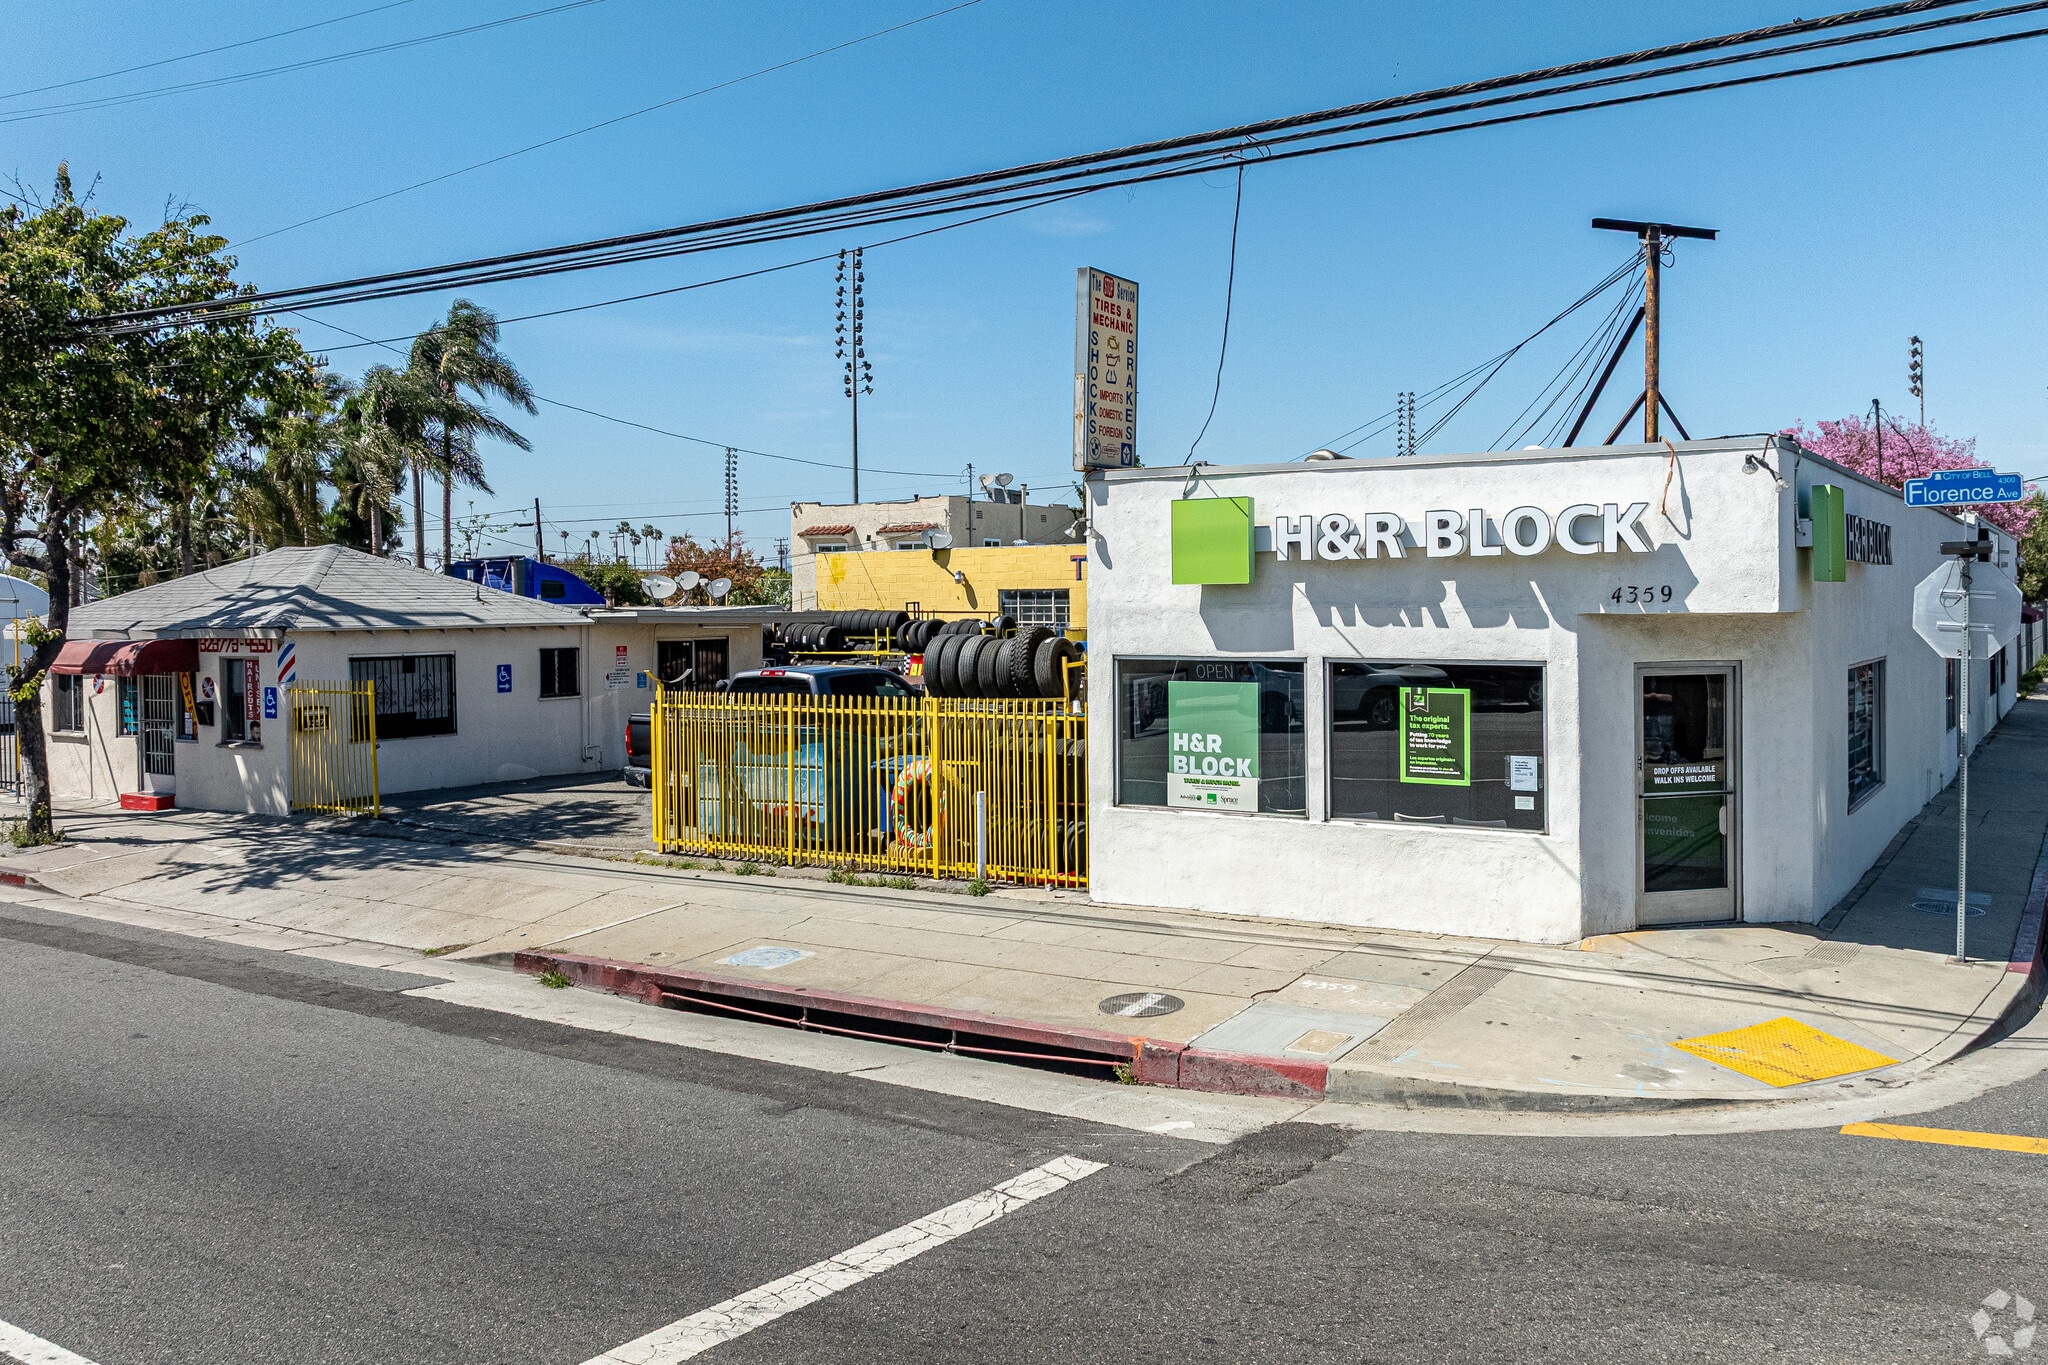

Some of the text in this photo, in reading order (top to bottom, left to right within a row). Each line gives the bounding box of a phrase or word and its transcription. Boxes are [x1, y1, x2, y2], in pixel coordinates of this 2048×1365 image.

[1117, 282, 1135, 303] Service
[1094, 297, 1132, 320] TIRES &
[1093, 312, 1133, 334] MECHANIC
[1090, 331, 1099, 434] SHOCKS
[1126, 339, 1134, 440] BRAKES
[1100, 390, 1124, 404] IMPORTS
[1099, 407, 1123, 421] DOMESTIC
[1099, 425, 1123, 439] FOREIGN
[1943, 472, 1961, 481] CITY
[1973, 471, 1992, 479] BELL
[1909, 482, 2018, 503] Florence Ave
[1276, 502, 1656, 562] H&R BLOCK
[1846, 514, 1894, 565] H&R BLOCK
[1611, 585, 1674, 605] 4359
[1196, 664, 1234, 680] OPEN
[1423, 715, 1450, 723] original
[1173, 732, 1222, 753] H&R
[1173, 755, 1252, 777] BLOCK
[1653, 765, 1715, 775] DROP OFFS AVAILABLE
[1654, 776, 1672, 784] WALK
[1685, 774, 1716, 782] WELCOME
[1220, 796, 1239, 804] Spruce
